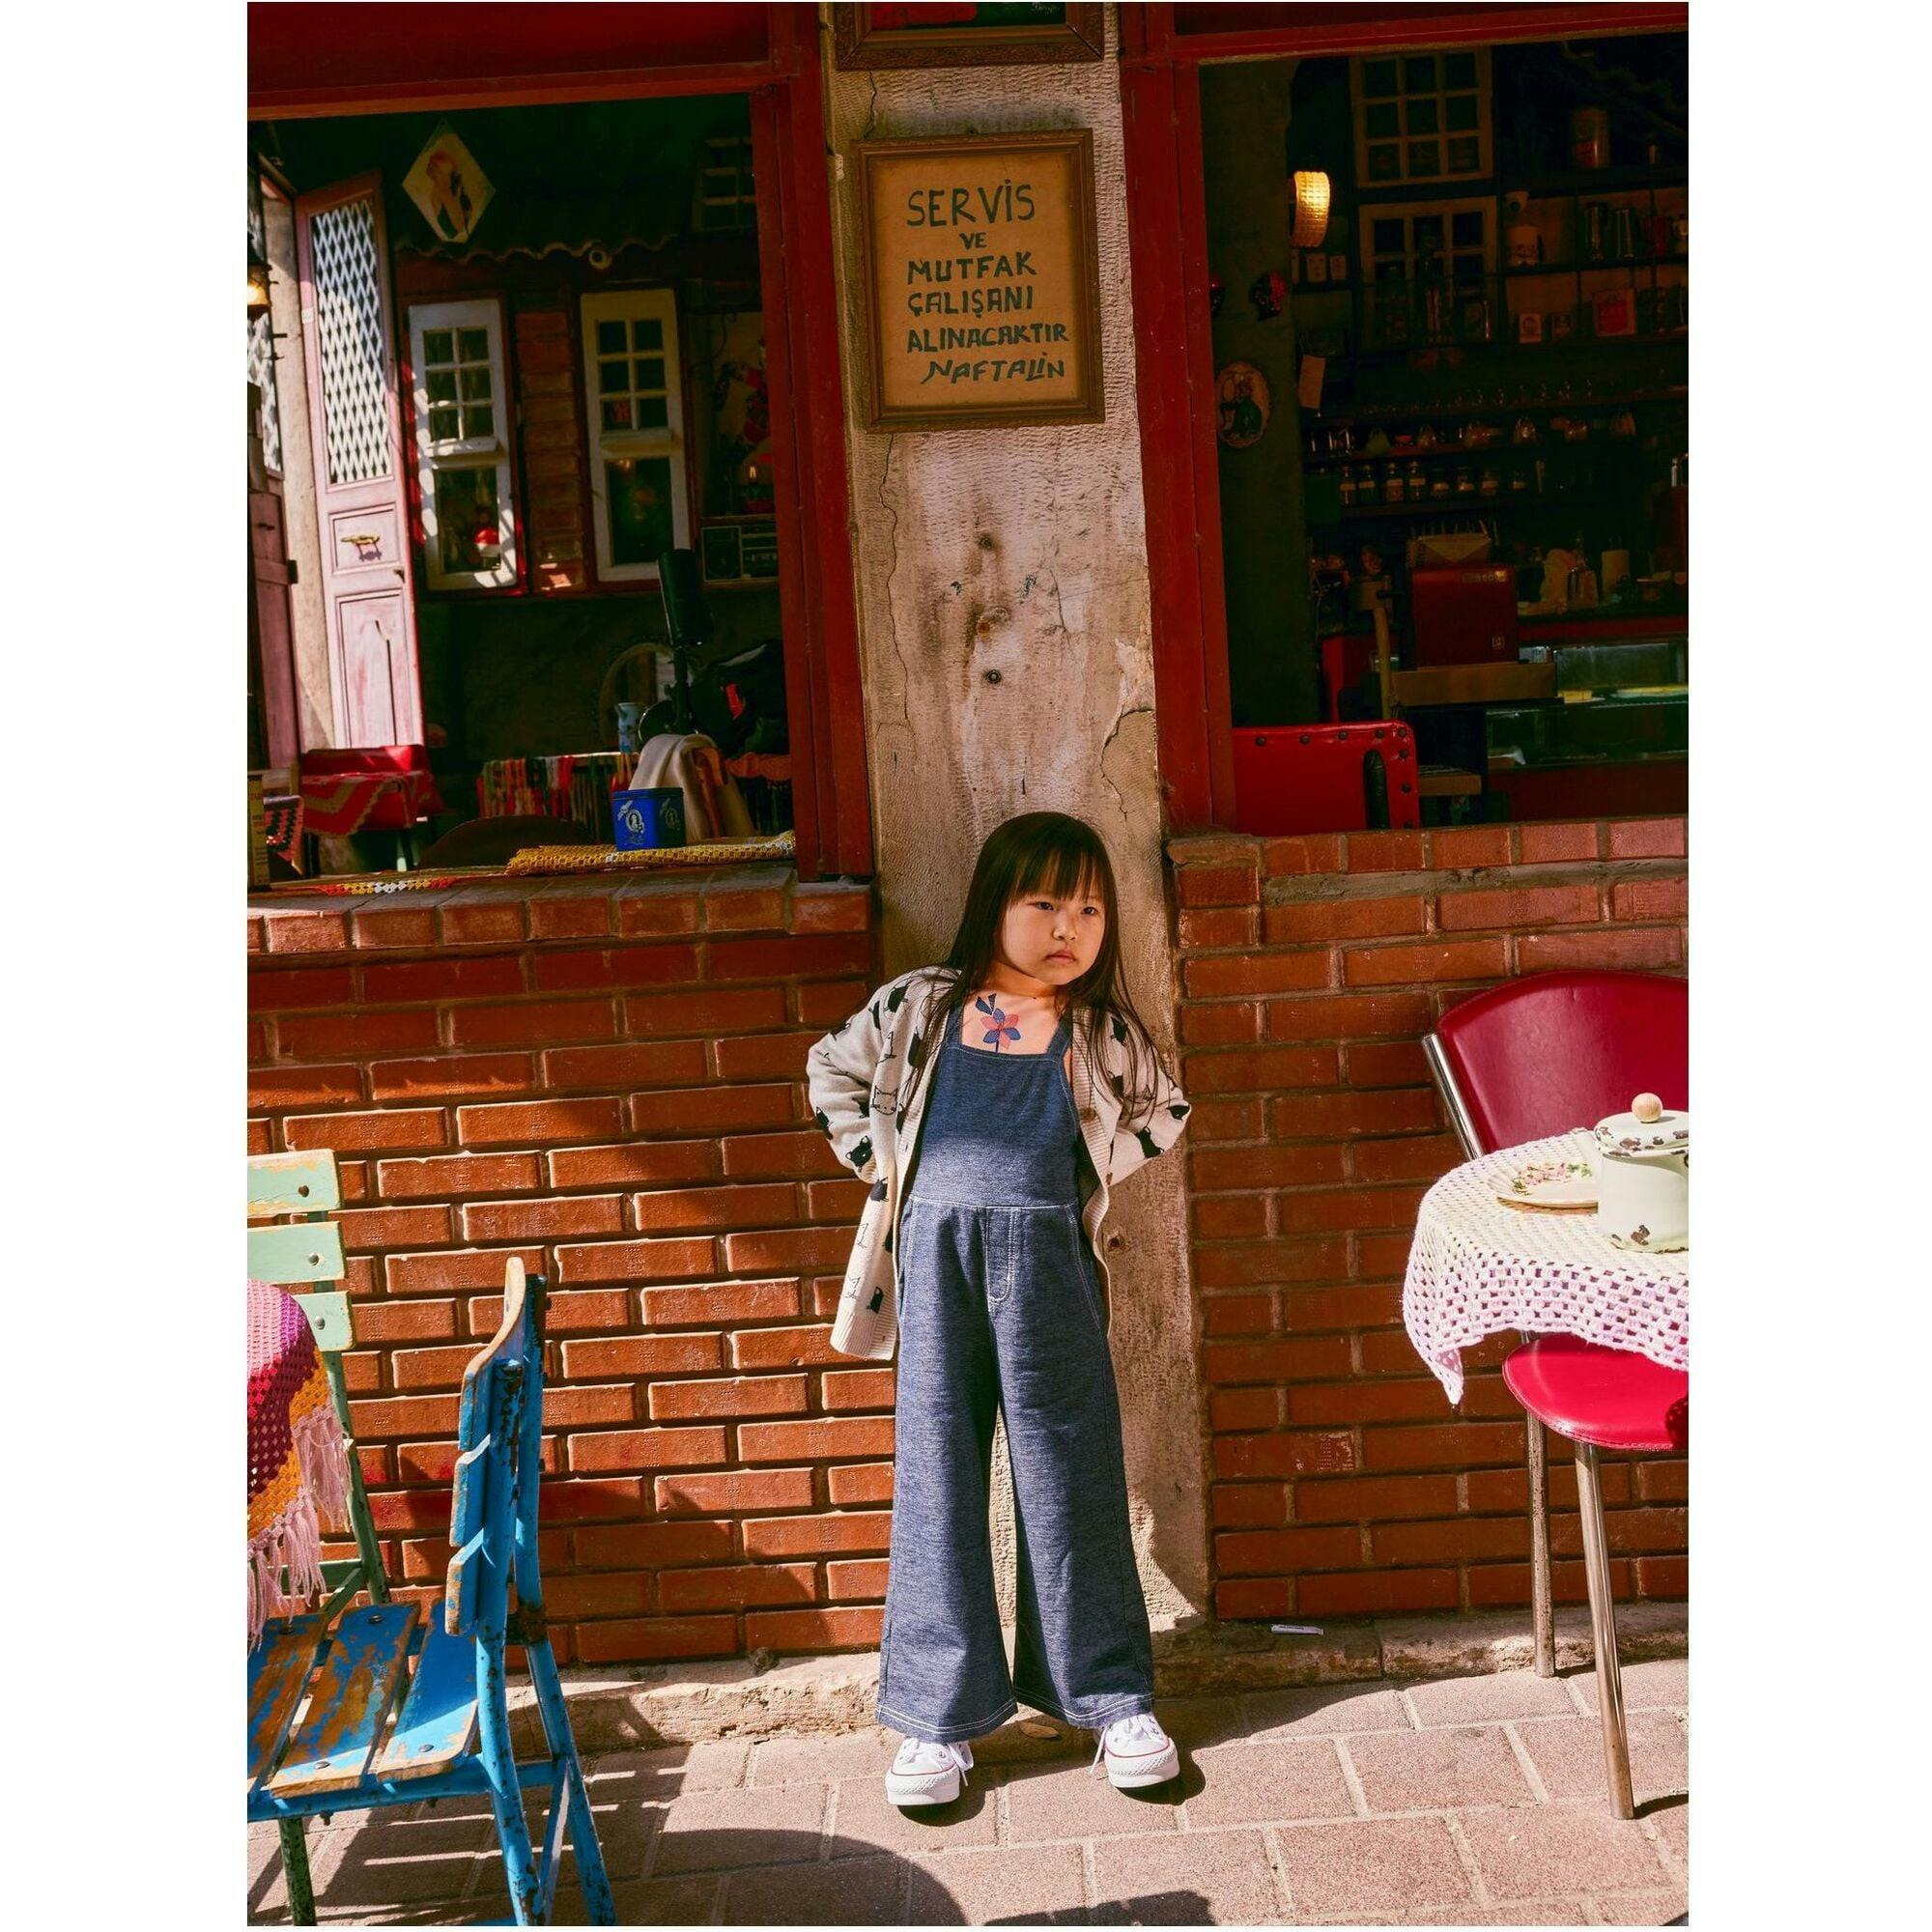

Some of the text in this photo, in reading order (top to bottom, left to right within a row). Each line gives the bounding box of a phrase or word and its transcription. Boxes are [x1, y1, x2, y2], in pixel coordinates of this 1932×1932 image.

[907, 180, 1035, 227] SERVİS
[959, 232, 987, 249] VE
[908, 252, 1037, 285] MUTFAK
[908, 286, 1033, 318] ÇALIŞANI
[907, 324, 1069, 353] ALINACAKTIR
[921, 352, 1065, 384] NAFTALİN
